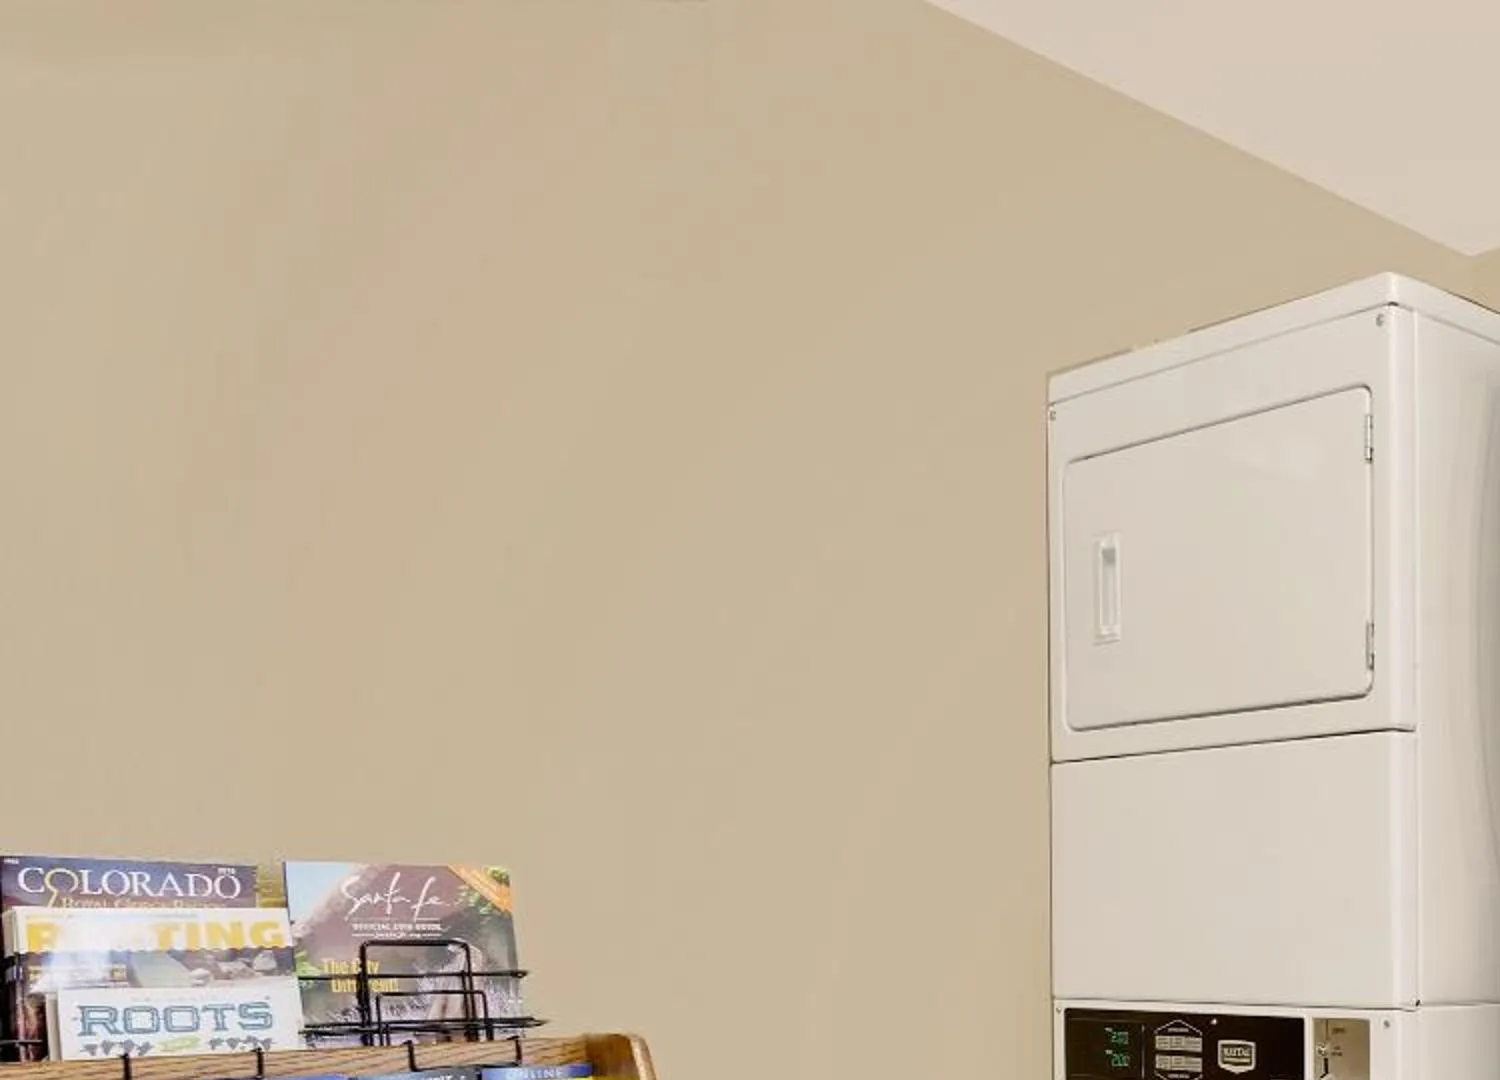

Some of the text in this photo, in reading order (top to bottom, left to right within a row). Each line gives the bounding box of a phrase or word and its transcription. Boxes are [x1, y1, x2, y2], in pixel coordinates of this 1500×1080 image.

[17, 867, 242, 900] COLORADO
[340, 872, 411, 922] Santa
[26, 919, 286, 953] RTING
[352, 958, 380, 974] Cty
[77, 1001, 273, 1037] ROOTS
